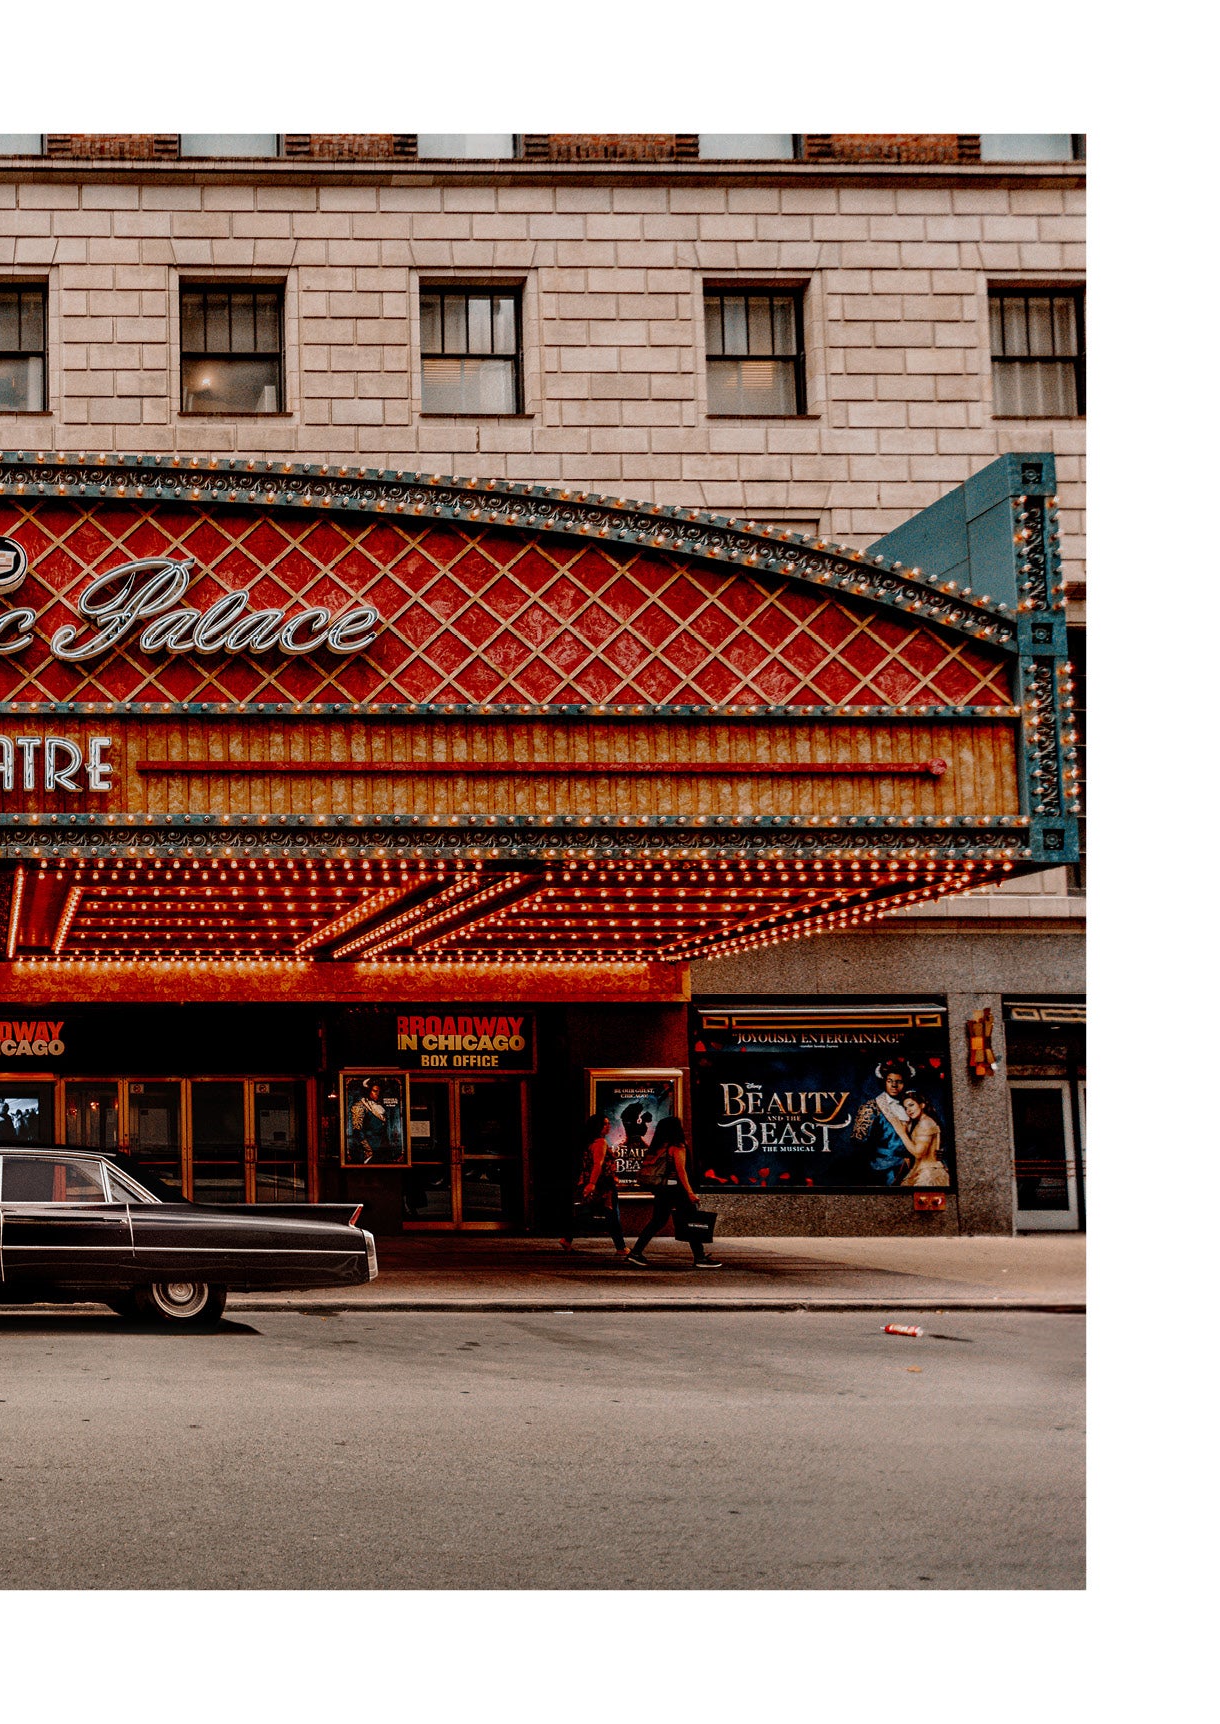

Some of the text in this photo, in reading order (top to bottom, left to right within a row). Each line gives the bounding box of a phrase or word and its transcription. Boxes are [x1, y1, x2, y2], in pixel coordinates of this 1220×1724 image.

[50, 556, 378, 663] Palace
[397, 1015, 524, 1037] BROADWAY
[397, 1034, 525, 1051] IN CHICAGO
[421, 1054, 499, 1067] BOX OFFICE
[720, 1083, 850, 1122] BEAUTY
[717, 1114, 852, 1153] BEAST
